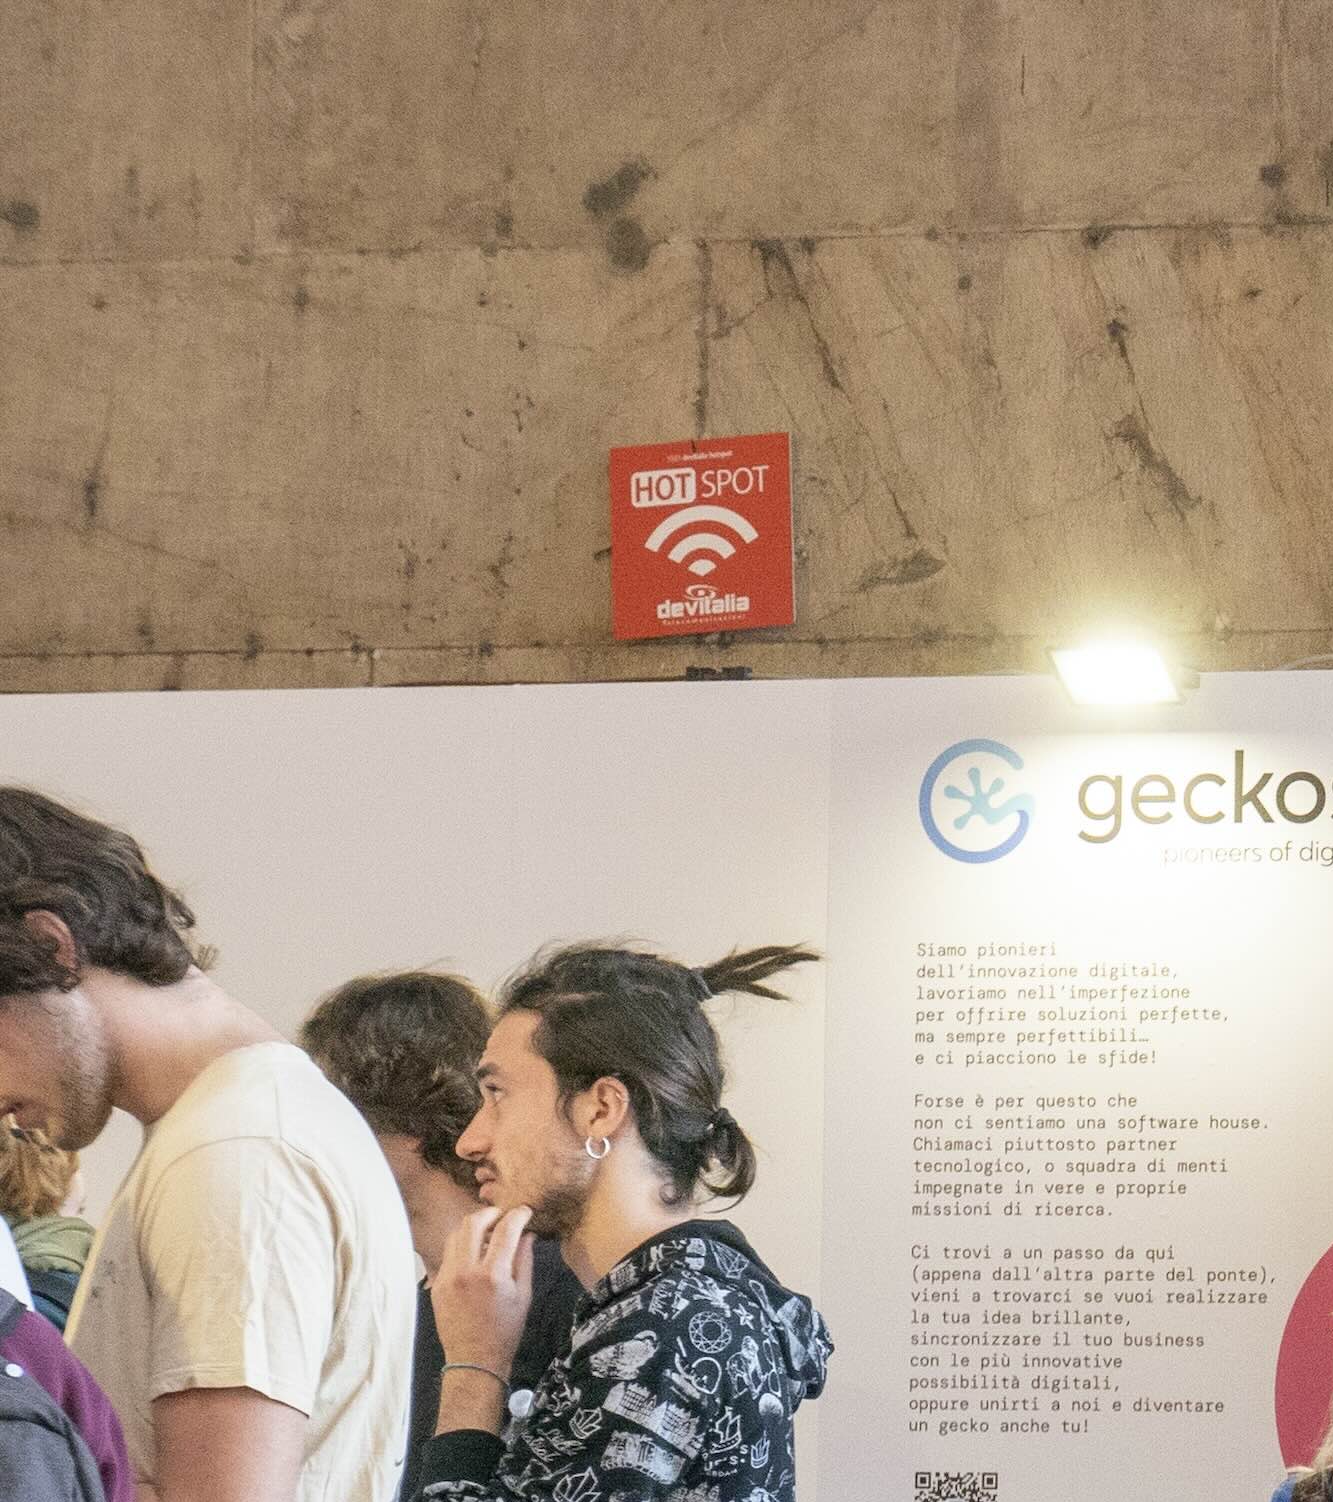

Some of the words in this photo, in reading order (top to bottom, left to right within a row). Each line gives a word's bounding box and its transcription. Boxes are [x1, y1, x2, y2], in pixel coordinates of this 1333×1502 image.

[634, 472, 691, 503] HOT
[702, 465, 769, 498] SPOT
[656, 593, 750, 620] devitalia
[1269, 841, 1294, 862] of
[917, 942, 967, 957] Siamo
[977, 942, 1056, 959] pionieri
[1089, 963, 1177, 981] digitale,
[916, 985, 1007, 1000] lavoriamo
[915, 1010, 945, 1025] per
[956, 1007, 1026, 1025] offrire
[1038, 1006, 1127, 1021] soluzioni
[1139, 1005, 1228, 1024] perfette,
[914, 1032, 935, 1044] ma
[946, 1032, 1006, 1046] sempre
[915, 1053, 924, 1065] e
[935, 1050, 954, 1065] ci
[965, 1050, 1056, 1068] piacciono
[1067, 1049, 1087, 1064] le
[1098, 1049, 1156, 1068] sfide!
[914, 1093, 964, 1108] Forse
[975, 1093, 984, 1108] è
[995, 1096, 1025, 1111] per
[1036, 1095, 1097, 1111] questo
[1107, 1092, 1138, 1108] che
[914, 1118, 943, 1130] non
[954, 1115, 973, 1130] ci
[985, 1115, 1066, 1130] sentiamo
[1076, 1118, 1106, 1130] una
[1118, 1114, 1199, 1132] software
[1209, 1114, 1268, 1130] house.
[913, 1136, 993, 1151] Chiamaci
[1004, 1136, 1096, 1155] piuttosto
[1106, 1138, 1177, 1155] partner
[913, 1158, 1031, 1177] tecnologico,
[1044, 1162, 1055, 1173] o
[1066, 1158, 1136, 1176] squadra
[1147, 1158, 1166, 1173] di
[1177, 1158, 1228, 1173] menti
[913, 1179, 1003, 1199] impegnate
[1015, 1179, 1034, 1195] in
[1044, 1183, 1085, 1195] vere
[1095, 1183, 1105, 1195] e
[1116, 1180, 1187, 1199] proprie
[911, 1201, 992, 1217] missioni
[1003, 1201, 1023, 1216] di
[1035, 1201, 1112, 1217] ricerca.
[911, 1244, 930, 1260] Ci
[943, 1244, 991, 1260] trovi
[1003, 1248, 1012, 1260] a
[1023, 1248, 1043, 1260] un
[1053, 1248, 1104, 1264] passo
[1114, 1244, 1134, 1260] da
[1145, 1244, 1175, 1264] qui
[912, 1264, 981, 1285] (appena
[1104, 1268, 1155, 1285] parte
[1165, 1266, 1195, 1282] del
[1207, 1265, 1275, 1285] ponte),
[910, 1287, 960, 1303] vieni
[972, 1291, 981, 1303] a
[992, 1288, 1072, 1303] trovarci
[1083, 1292, 1103, 1304] se
[1114, 1288, 1154, 1304] vuoi
[1166, 1288, 1268, 1304] realizzare
[911, 1308, 930, 1324] la
[942, 1310, 970, 1325] tua
[982, 1309, 1021, 1325] idea
[1032, 1309, 1130, 1327] brillante,
[910, 1331, 1041, 1347] sincronizzare
[1053, 1331, 1071, 1347] il
[1083, 1333, 1113, 1347] tuo
[1123, 1331, 1205, 1348] business
[910, 1355, 939, 1367] con
[950, 1352, 970, 1368] le
[980, 1352, 1010, 1371] più
[1022, 1353, 1123, 1369] innovative
[909, 1374, 1020, 1393] possibilità
[1031, 1375, 1119, 1394] digitali,
[909, 1399, 969, 1414] oppure
[980, 1396, 1040, 1411] unirti
[1051, 1400, 1060, 1412] a
[1071, 1397, 1101, 1412] noi
[1112, 1400, 1122, 1412] e
[1132, 1397, 1225, 1413] diventare
[909, 1421, 928, 1432] un
[938, 1417, 989, 1437] gecko
[1000, 1418, 1050, 1434] anche
[1061, 1418, 1088, 1434] tu!
